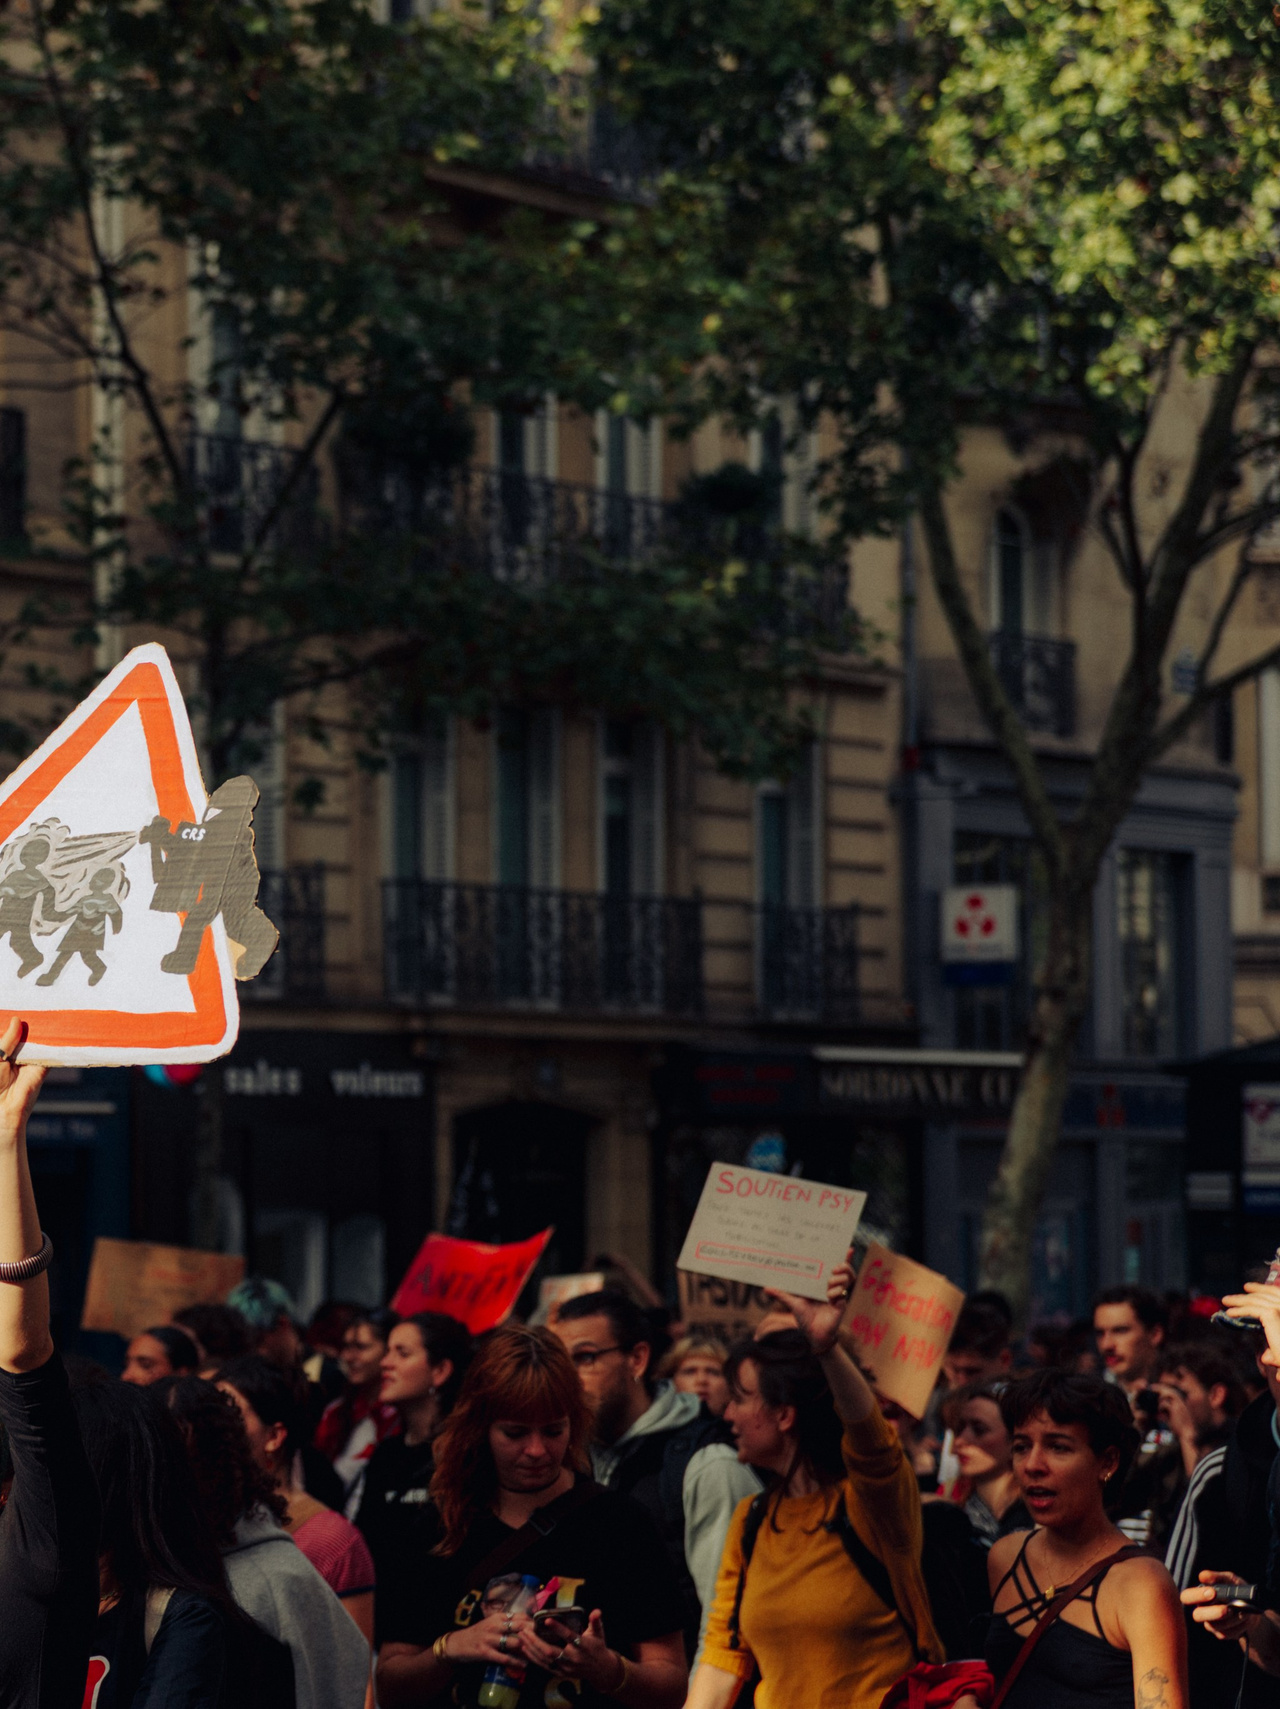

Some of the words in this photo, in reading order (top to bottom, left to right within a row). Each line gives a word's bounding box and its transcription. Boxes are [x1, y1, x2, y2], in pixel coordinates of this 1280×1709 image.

[181, 827, 206, 841] CRS
[225, 1059, 300, 1095] sales
[716, 1171, 812, 1204] SOUTIEN
[817, 1189, 855, 1214] PSY
